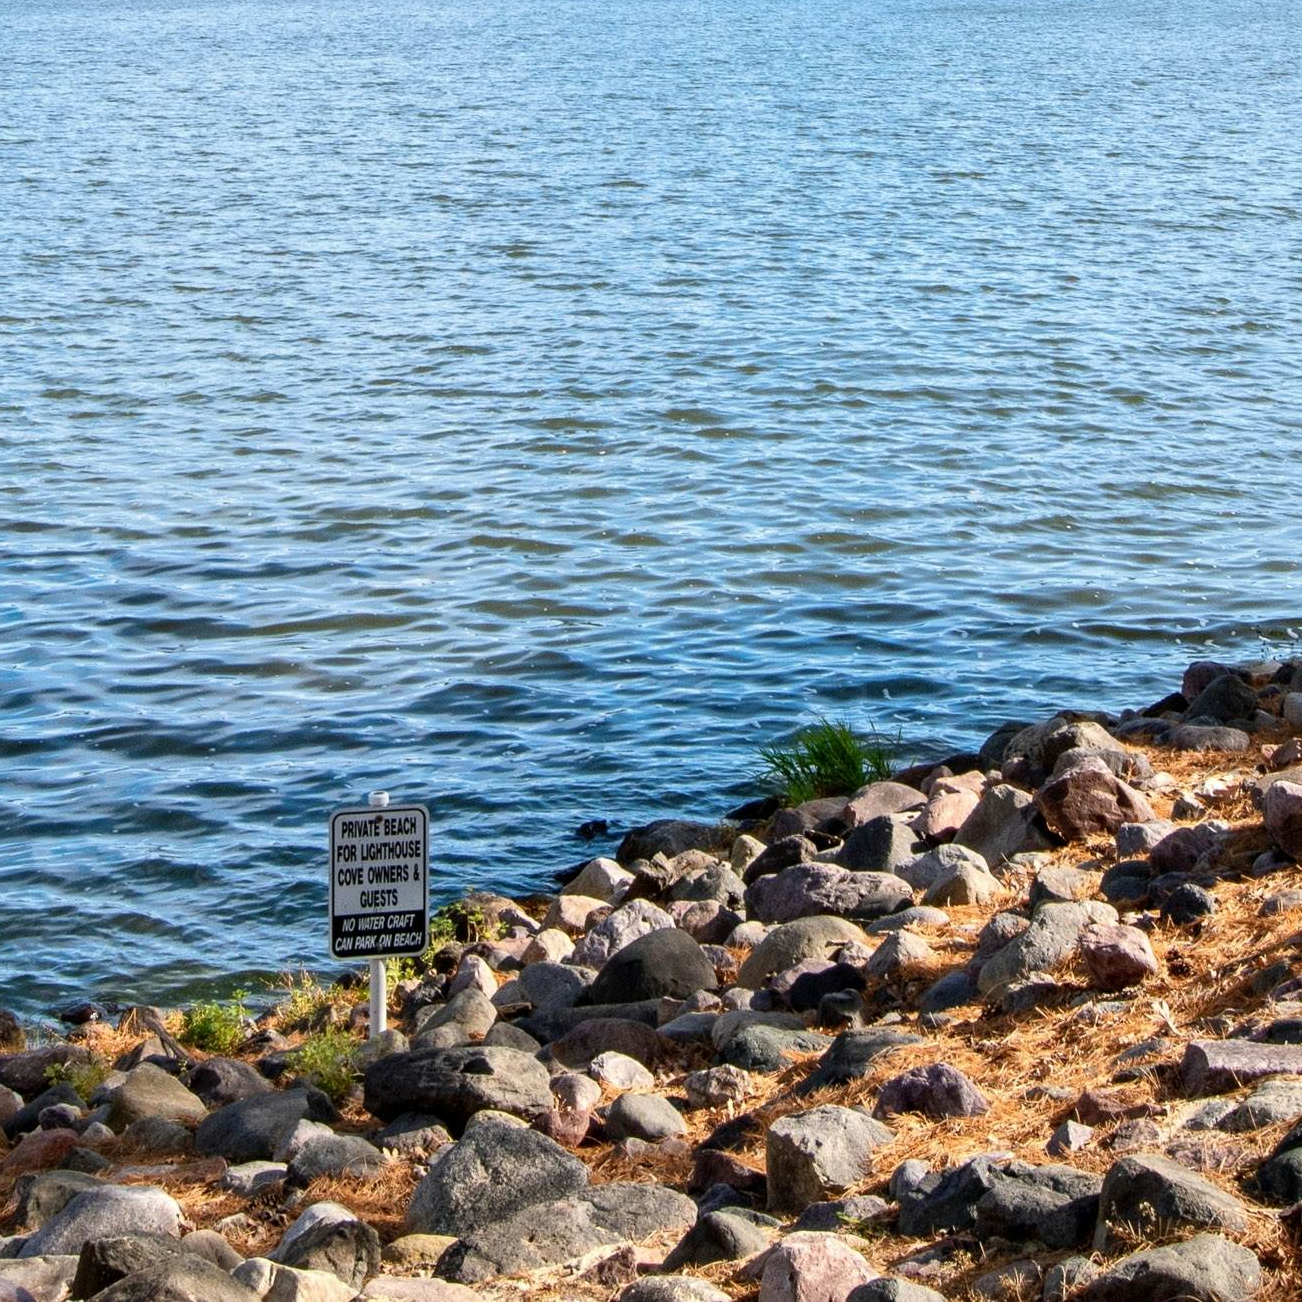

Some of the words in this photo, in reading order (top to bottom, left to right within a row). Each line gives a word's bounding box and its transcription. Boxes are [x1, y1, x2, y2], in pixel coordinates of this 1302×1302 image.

[342, 820, 380, 838] PRIVATE
[384, 818, 416, 835] BEACH
[337, 844, 356, 862] FOR
[361, 841, 420, 860] LIGHTHOUSE
[338, 868, 363, 886] COVE
[368, 865, 409, 884] OWNERS
[413, 864, 419, 881] &
[360, 889, 398, 908] GUESTS
[342, 918, 355, 932] NO
[359, 916, 384, 930] WATER
[387, 914, 415, 928] CRAFT
[336, 937, 352, 951] CAN
[355, 936, 376, 949] PARK
[379, 934, 392, 947] ON
[394, 932, 422, 947] BEACH
